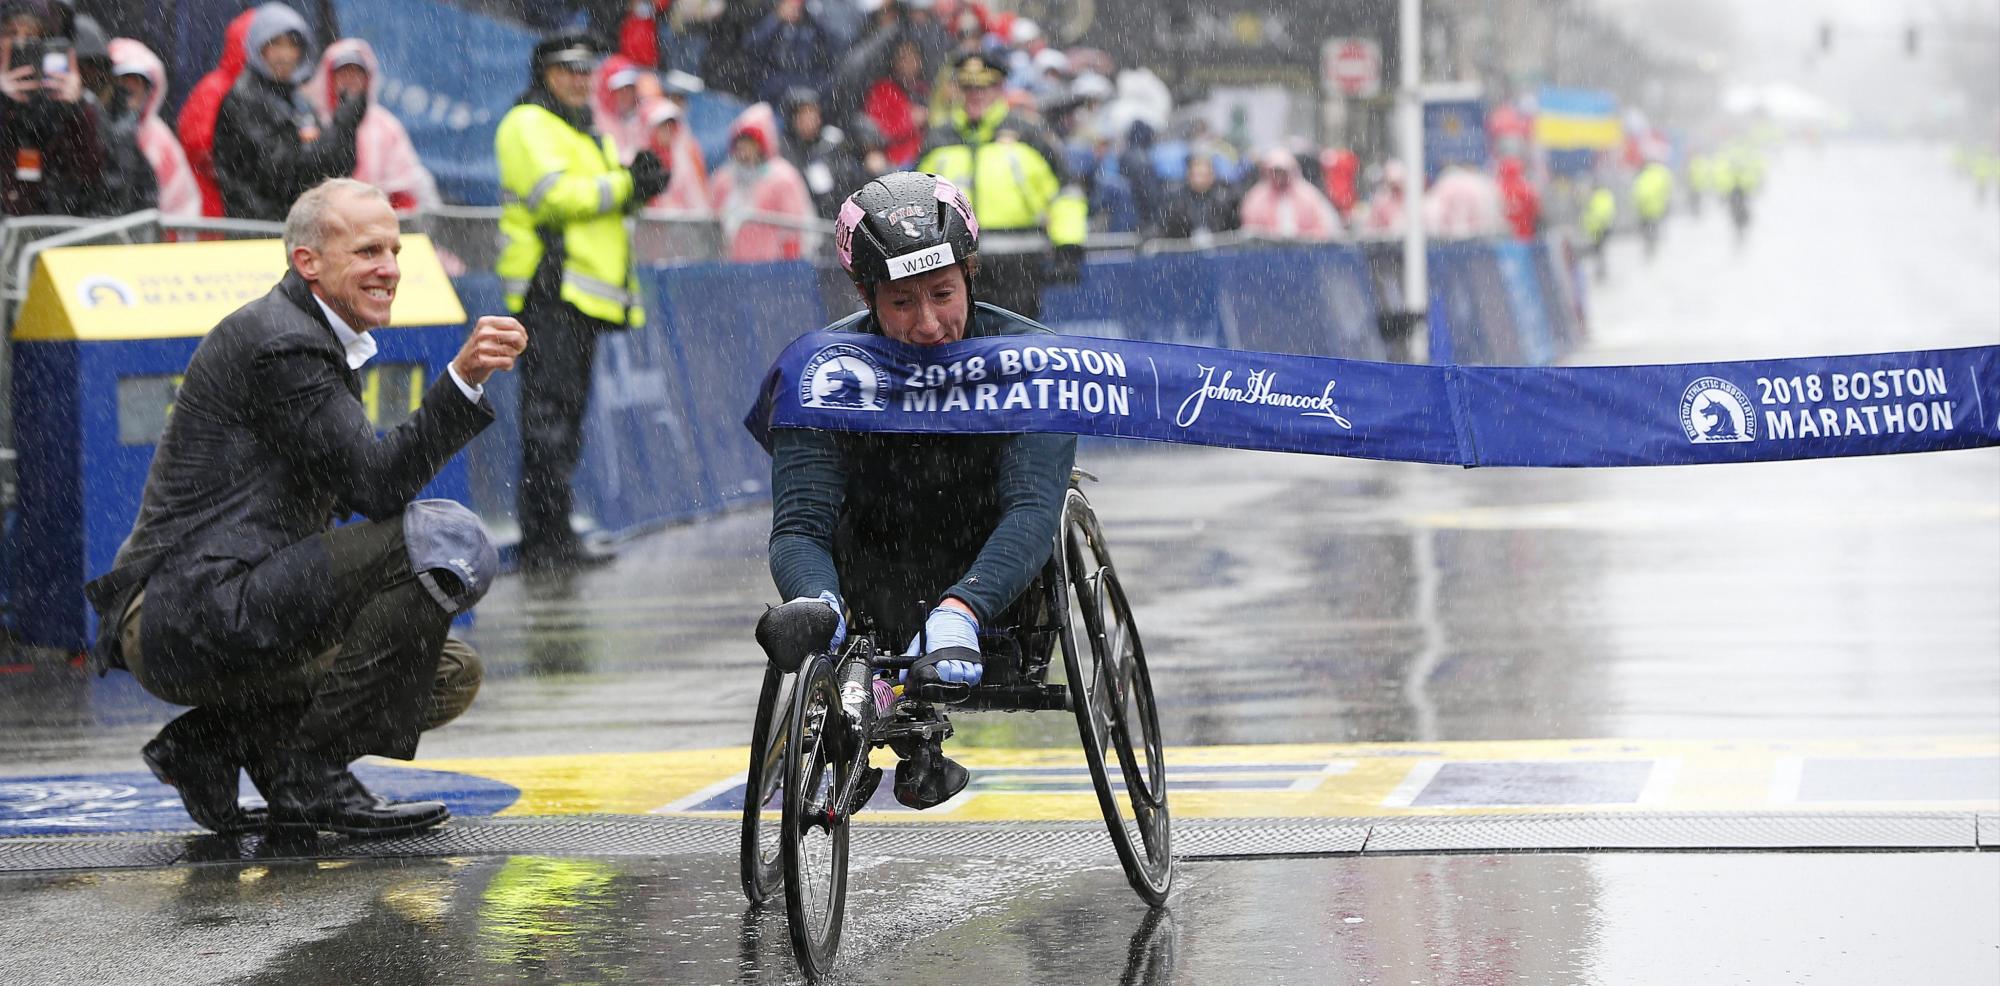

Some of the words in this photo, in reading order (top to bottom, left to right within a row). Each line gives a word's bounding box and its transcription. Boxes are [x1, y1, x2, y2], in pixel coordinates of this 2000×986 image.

[902, 252, 942, 273] W102
[904, 356, 987, 387] 2018
[998, 346, 1128, 378] BOSTON
[902, 378, 1131, 416] MARATHON
[1686, 379, 1719, 403] ATHLETIC
[1756, 374, 1824, 405] 2018
[1832, 367, 1948, 402] BOSTON
[1682, 402, 1697, 438] BOSTON
[1720, 382, 1755, 436] ASSOCIATION
[1765, 401, 1955, 441] MARATHON
